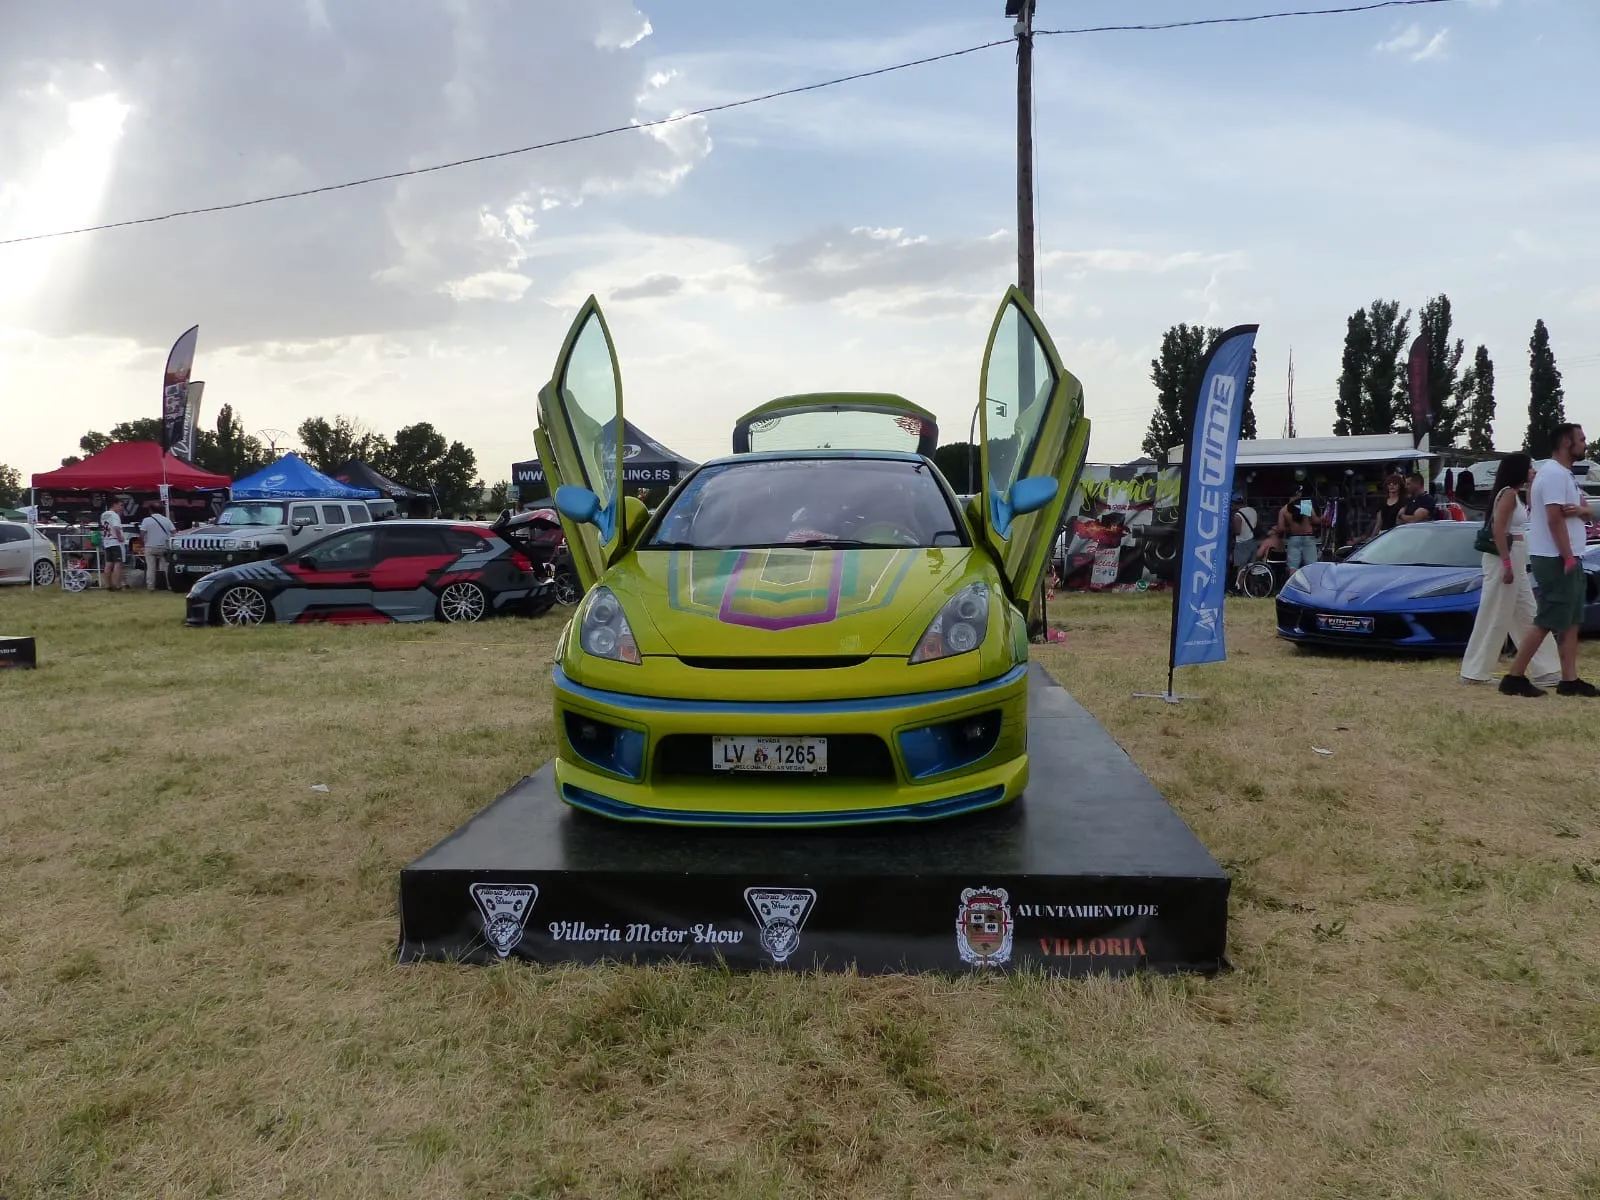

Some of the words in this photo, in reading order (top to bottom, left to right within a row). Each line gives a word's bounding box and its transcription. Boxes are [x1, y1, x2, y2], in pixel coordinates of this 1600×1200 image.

[1193, 377, 1232, 594] RACETIME
[724, 744, 745, 763] LV
[775, 745, 816, 764] 1265
[1016, 903, 1135, 918] AYUNTAMIENTO
[1137, 904, 1159, 916] DE
[548, 920, 621, 941] Villoria
[625, 923, 688, 942] Motor
[690, 923, 744, 943] Show
[1039, 937, 1148, 956] VILLORIA
